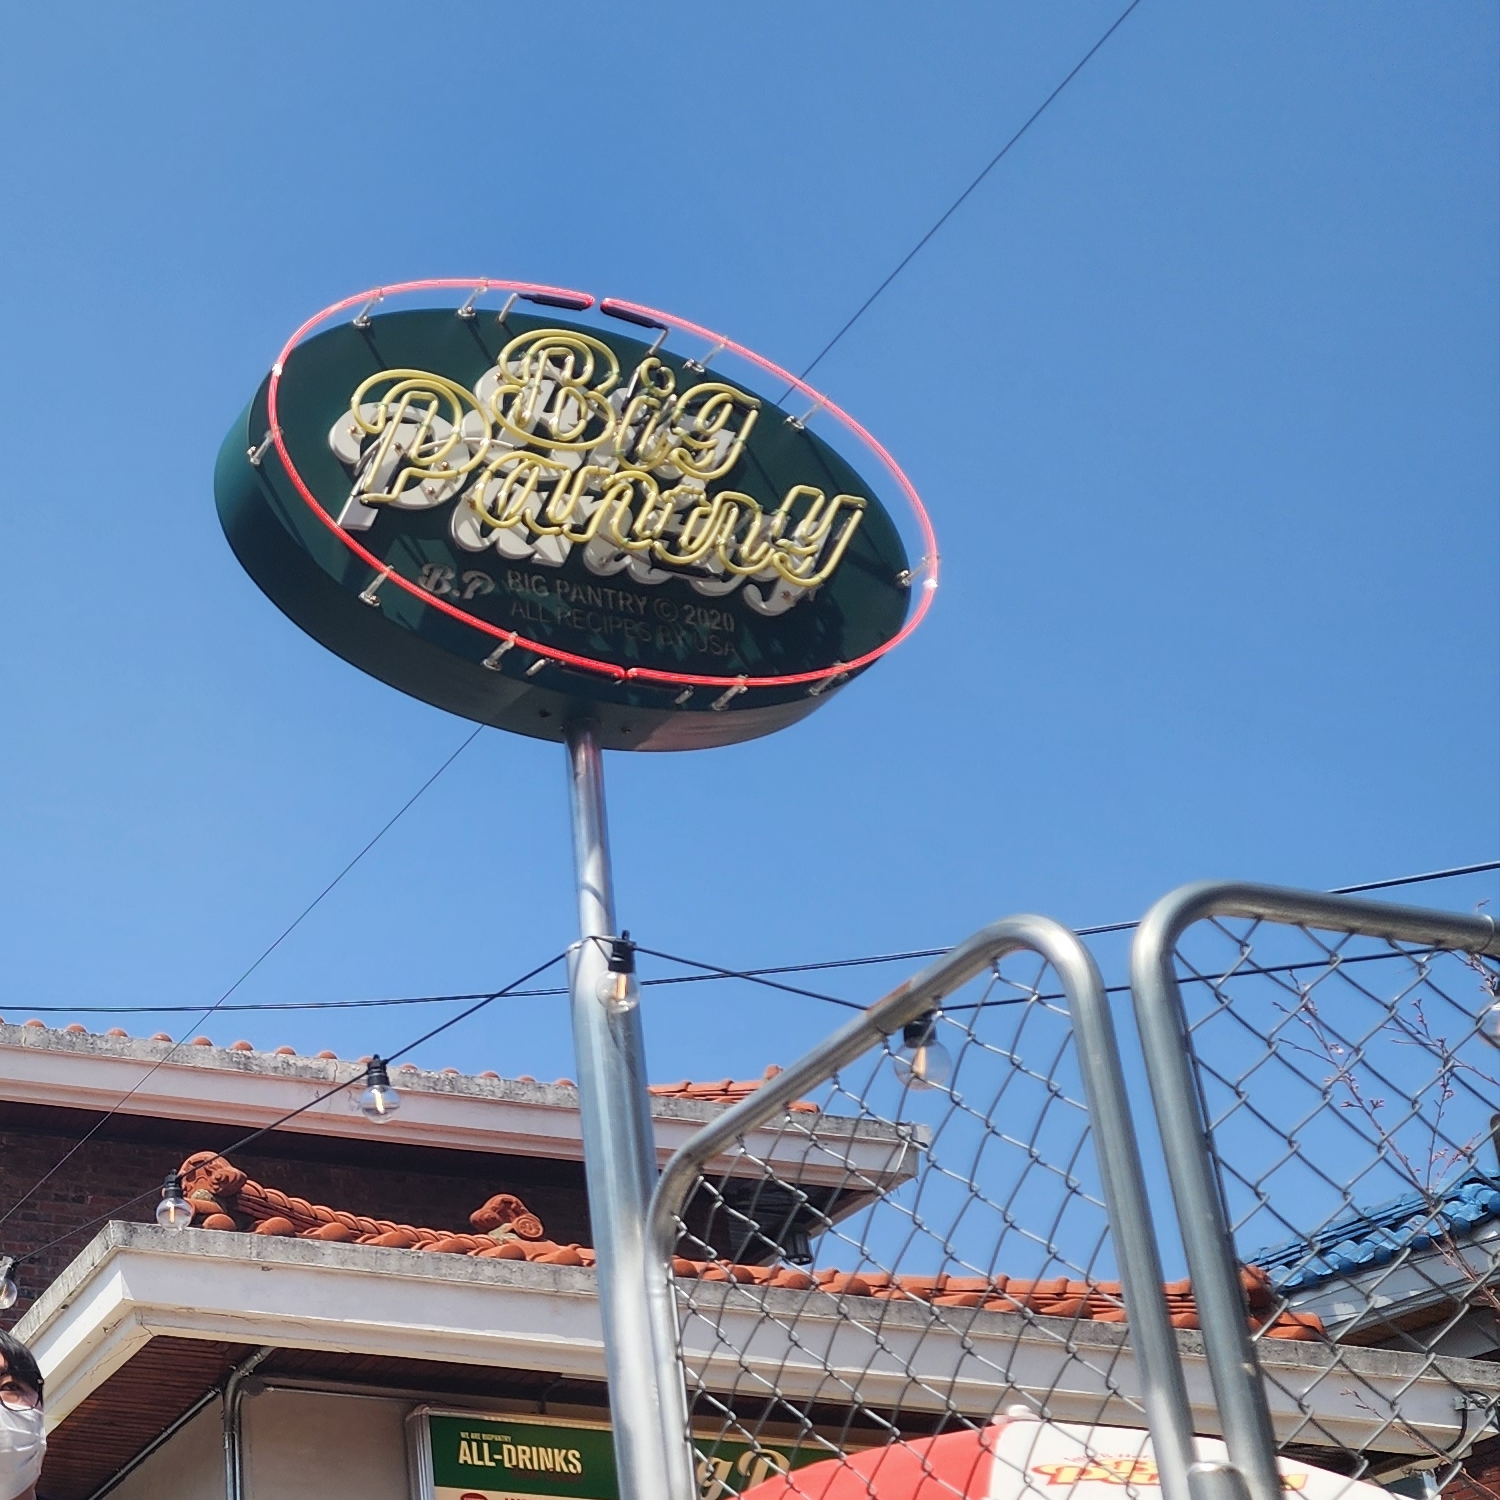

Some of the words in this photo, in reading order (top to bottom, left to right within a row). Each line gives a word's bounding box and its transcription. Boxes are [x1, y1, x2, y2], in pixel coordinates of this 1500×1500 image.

[485, 329, 762, 484] Big
[334, 369, 867, 604] Pantry
[506, 569, 549, 597] BIG
[555, 579, 648, 615] PANTRY
[683, 604, 736, 633] 2020
[510, 602, 551, 624] ALL
[555, 606, 651, 642] RECIPES
[696, 632, 738, 656] USA
[458, 1440, 583, 1474] ALL-DRINKS
